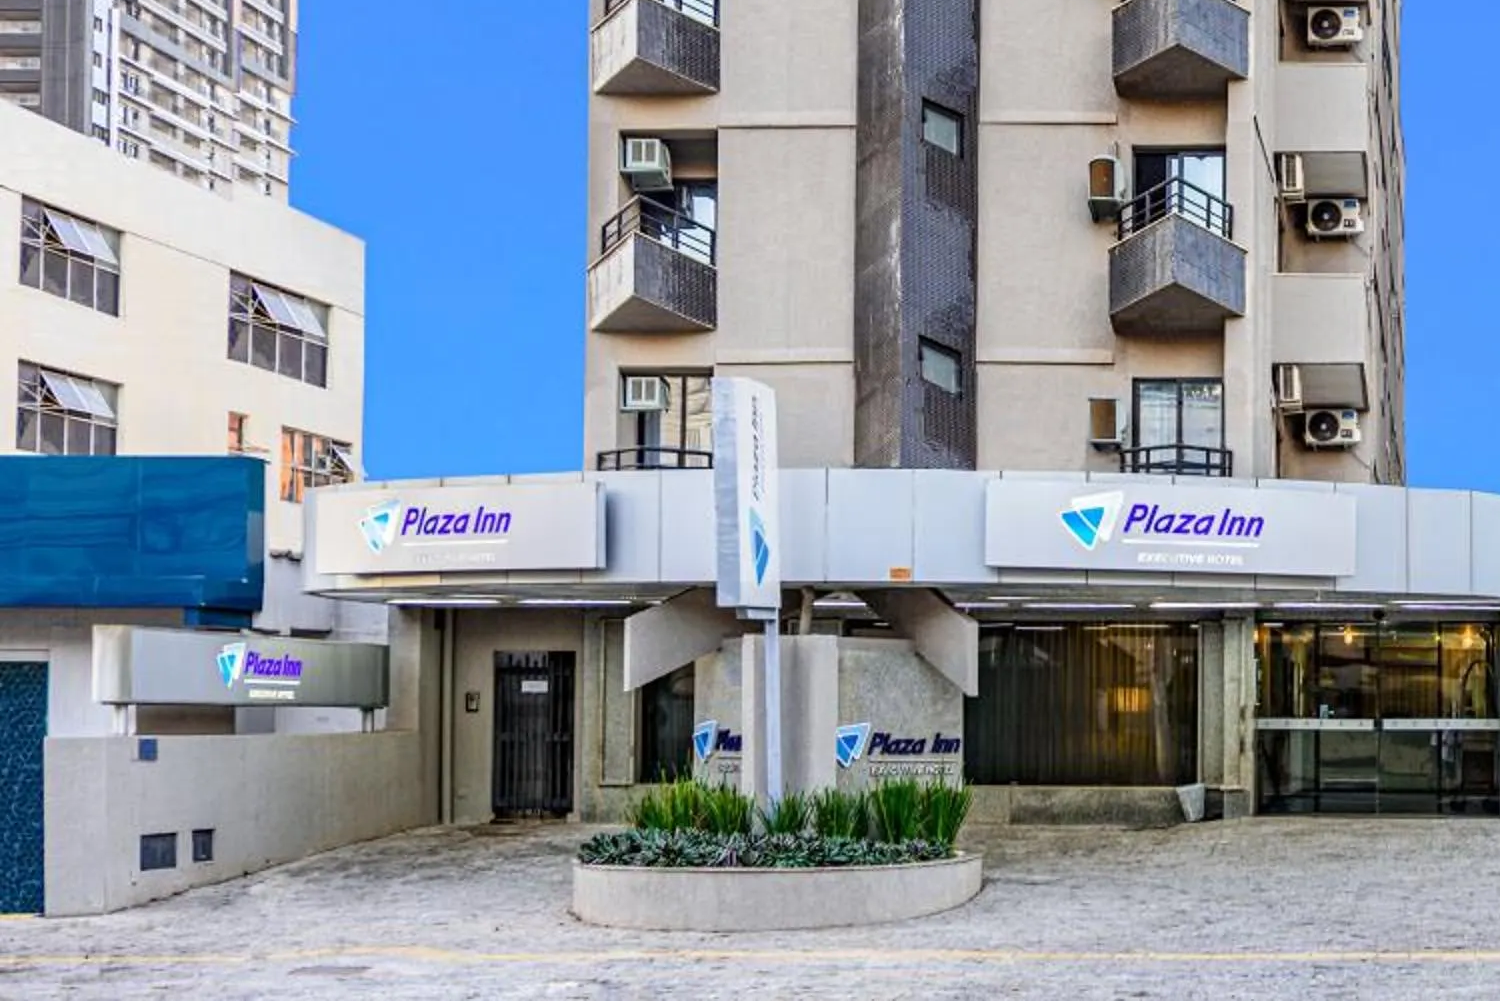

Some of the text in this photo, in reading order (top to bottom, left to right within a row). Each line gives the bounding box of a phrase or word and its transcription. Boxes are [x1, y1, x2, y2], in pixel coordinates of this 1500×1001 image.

[401, 505, 512, 536] Plaza Inn
[1123, 502, 1265, 538] Plaza Inn
[244, 651, 302, 677] Plaza Inn
[867, 731, 961, 756] Plaza Inn
